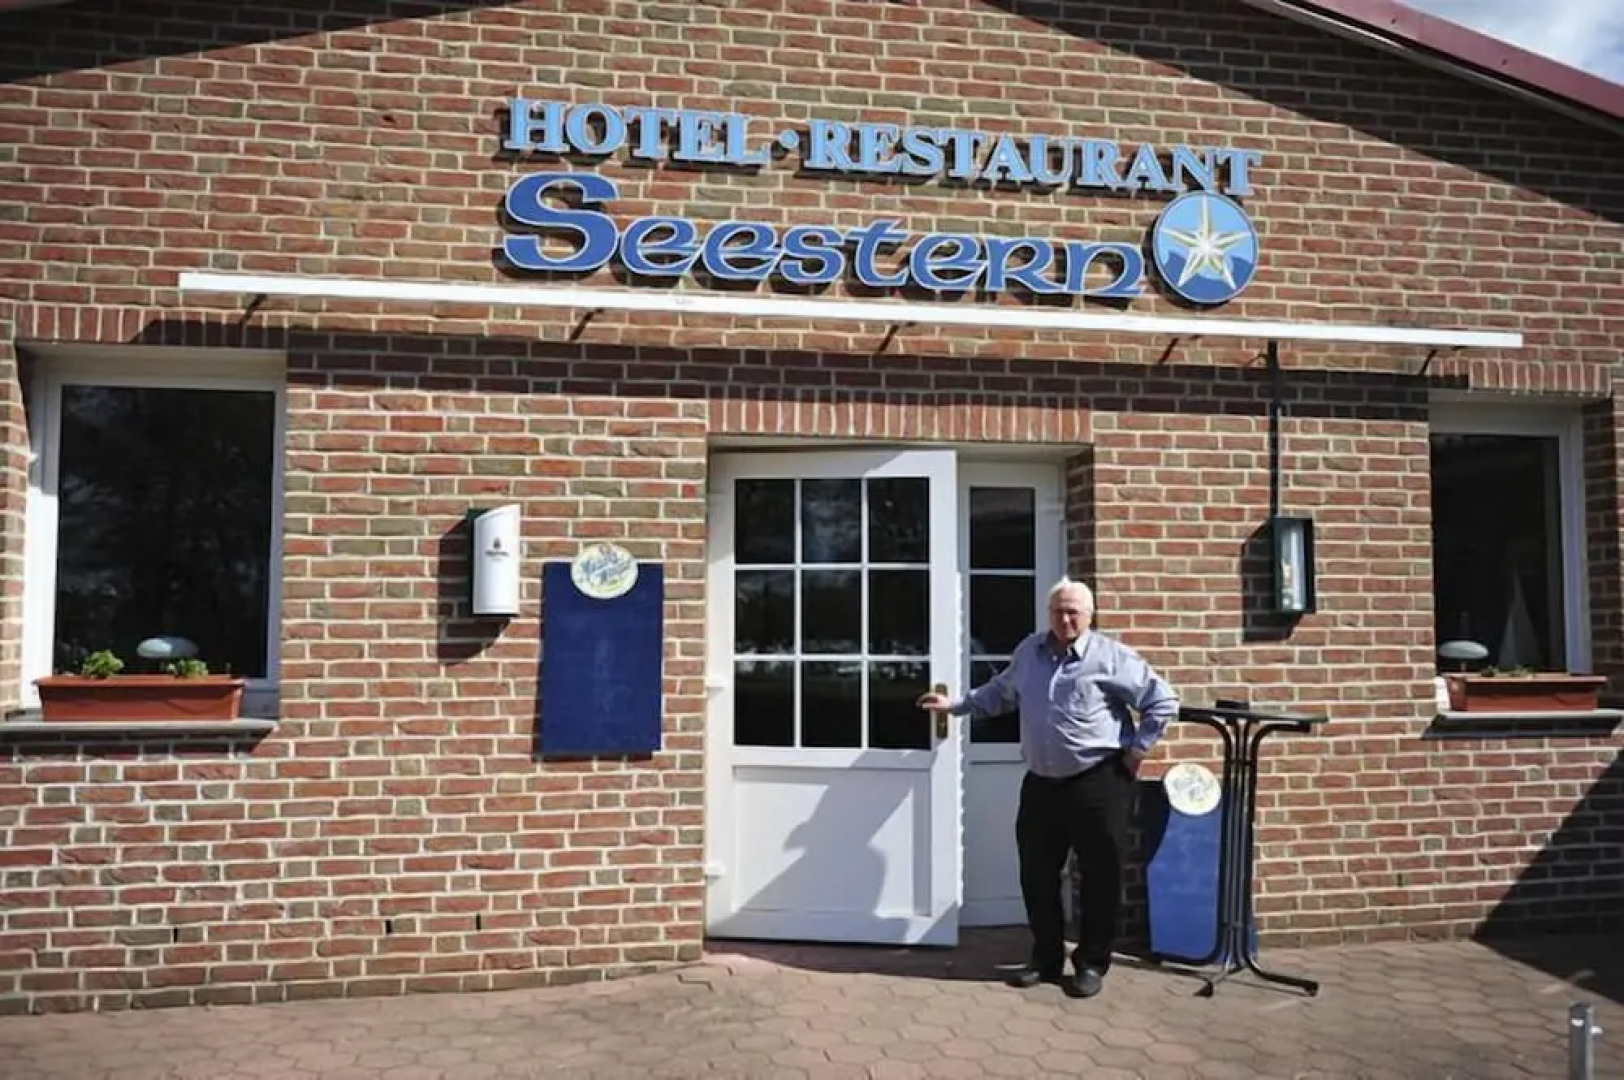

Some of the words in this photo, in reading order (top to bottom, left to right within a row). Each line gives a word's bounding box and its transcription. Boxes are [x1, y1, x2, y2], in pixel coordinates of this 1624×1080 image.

[504, 97, 771, 164] HOTEL
[804, 117, 1262, 196] RESTAURANT
[503, 171, 1145, 298] Seestern
